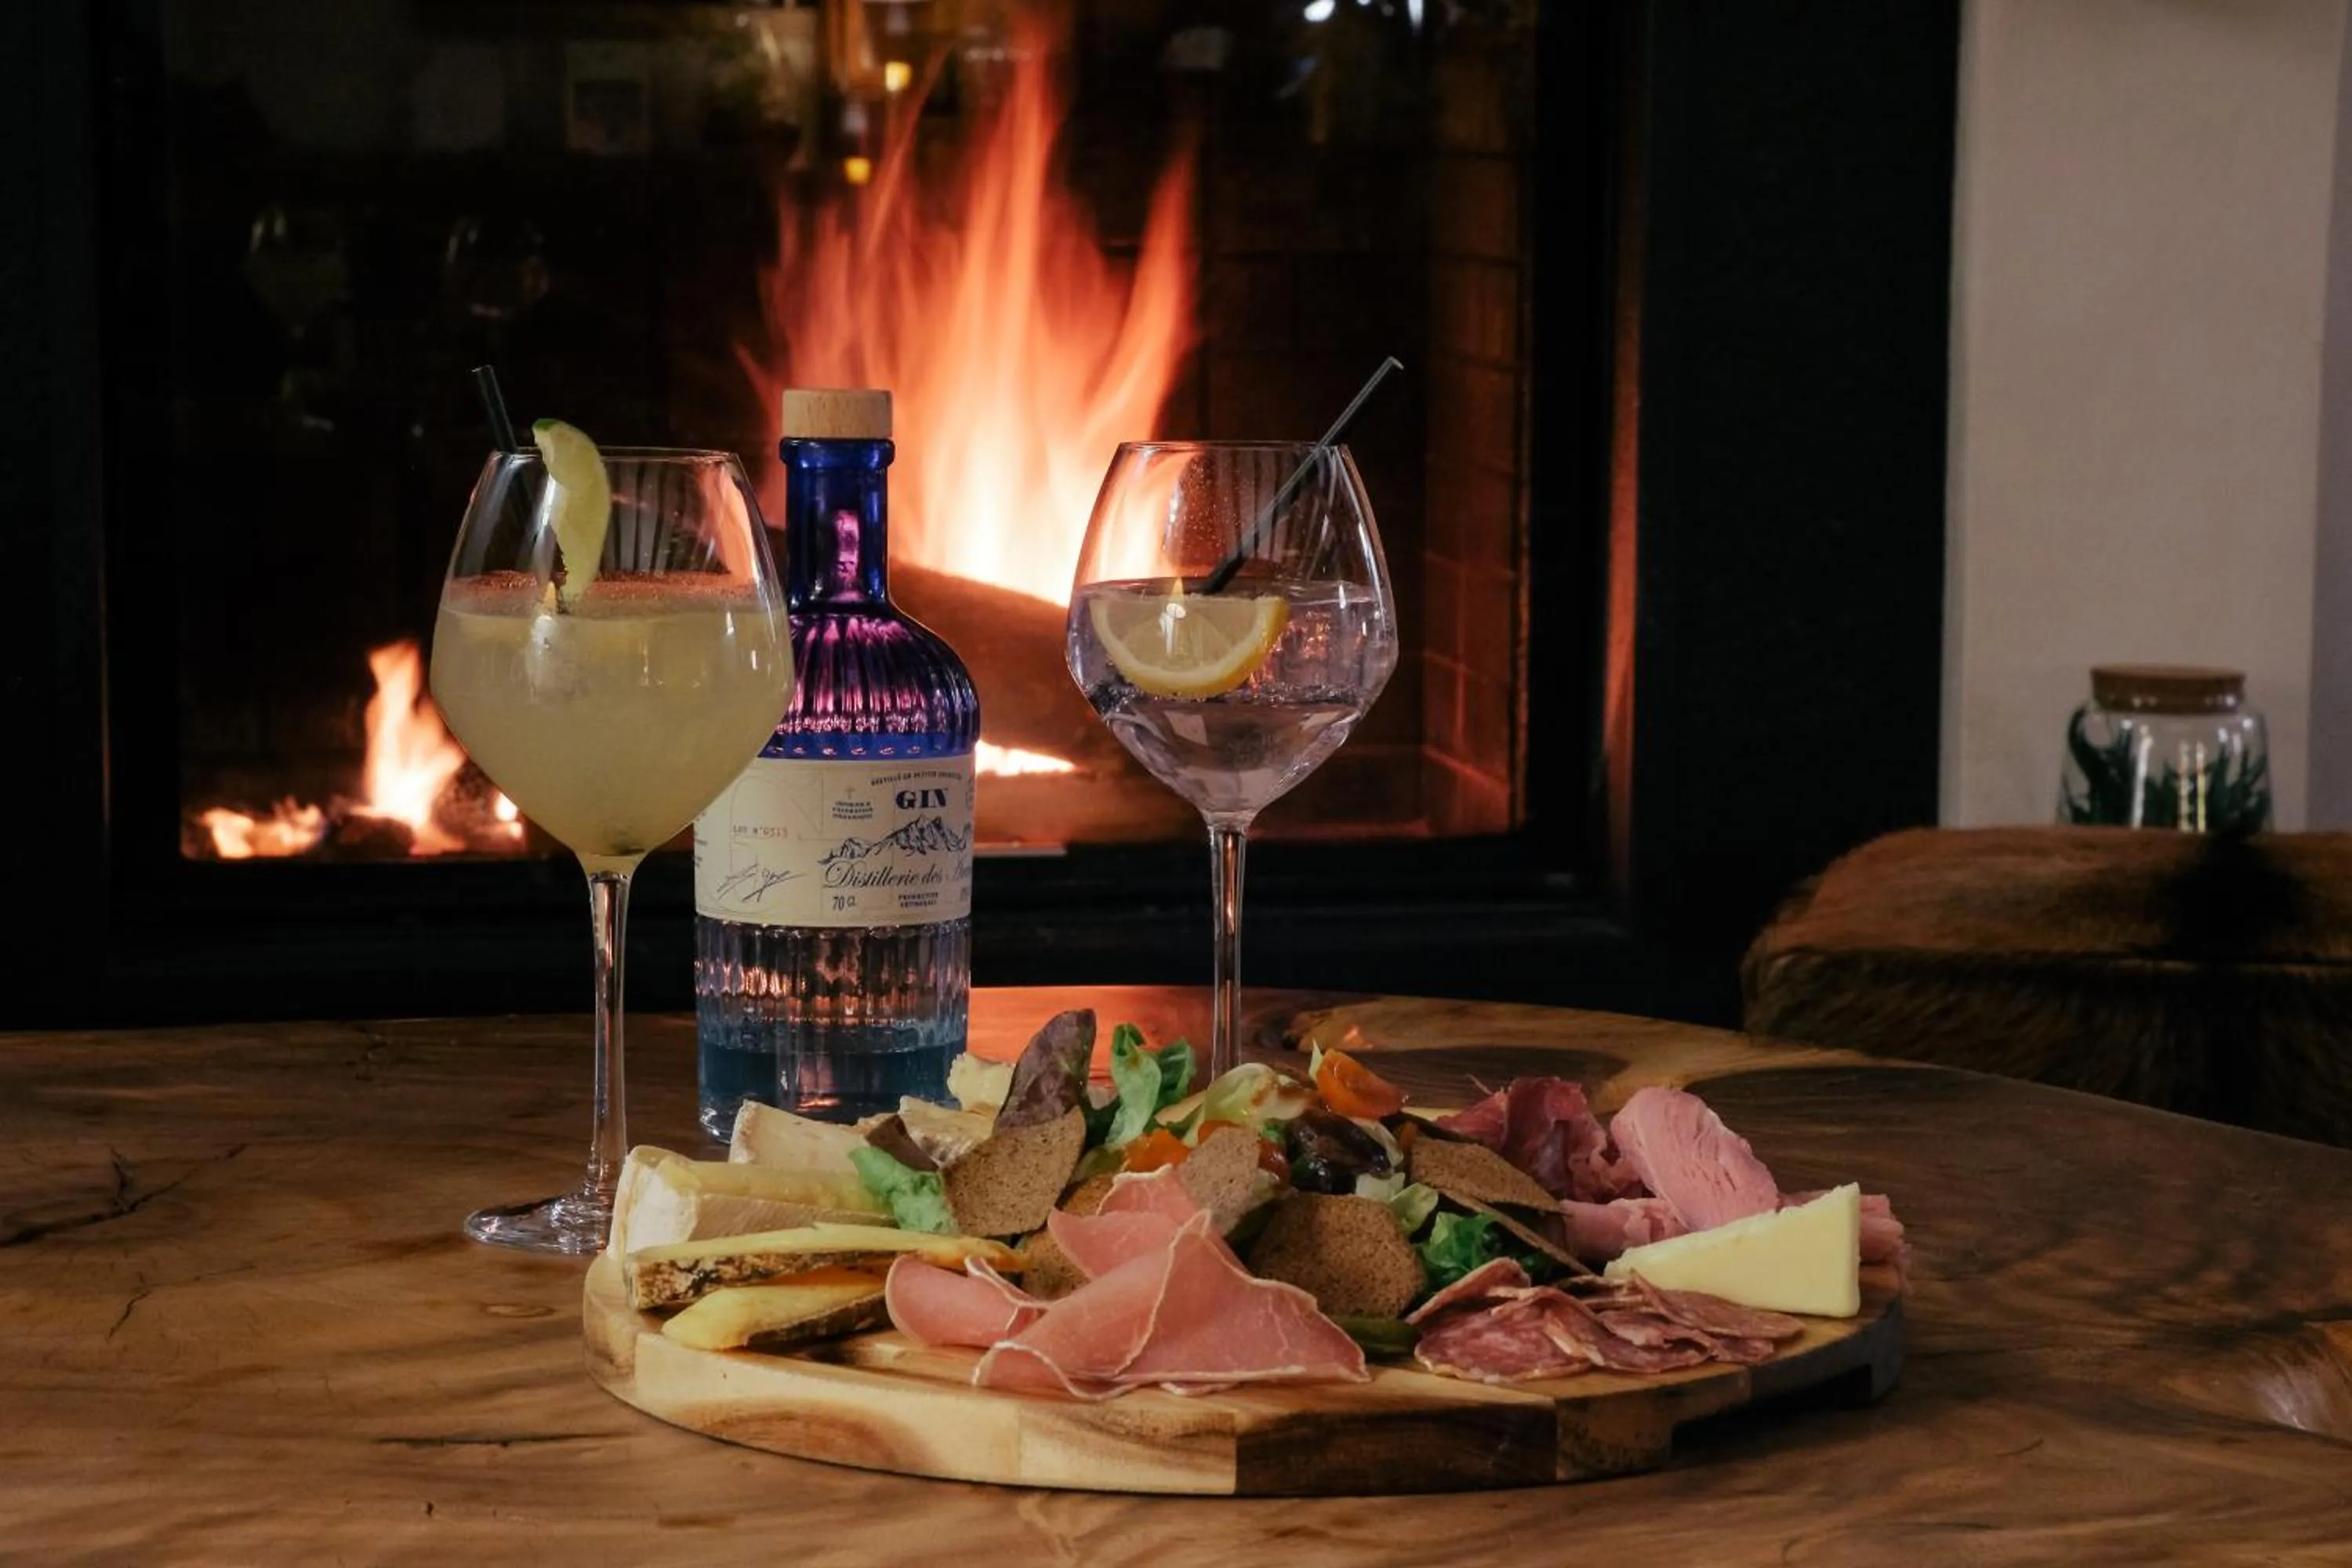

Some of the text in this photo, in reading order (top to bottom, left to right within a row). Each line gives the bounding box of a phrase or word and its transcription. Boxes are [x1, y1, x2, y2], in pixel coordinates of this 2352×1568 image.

[895, 788, 948, 809] GIN
[822, 861, 919, 888] Distillerie
[833, 895, 844, 911] 70
